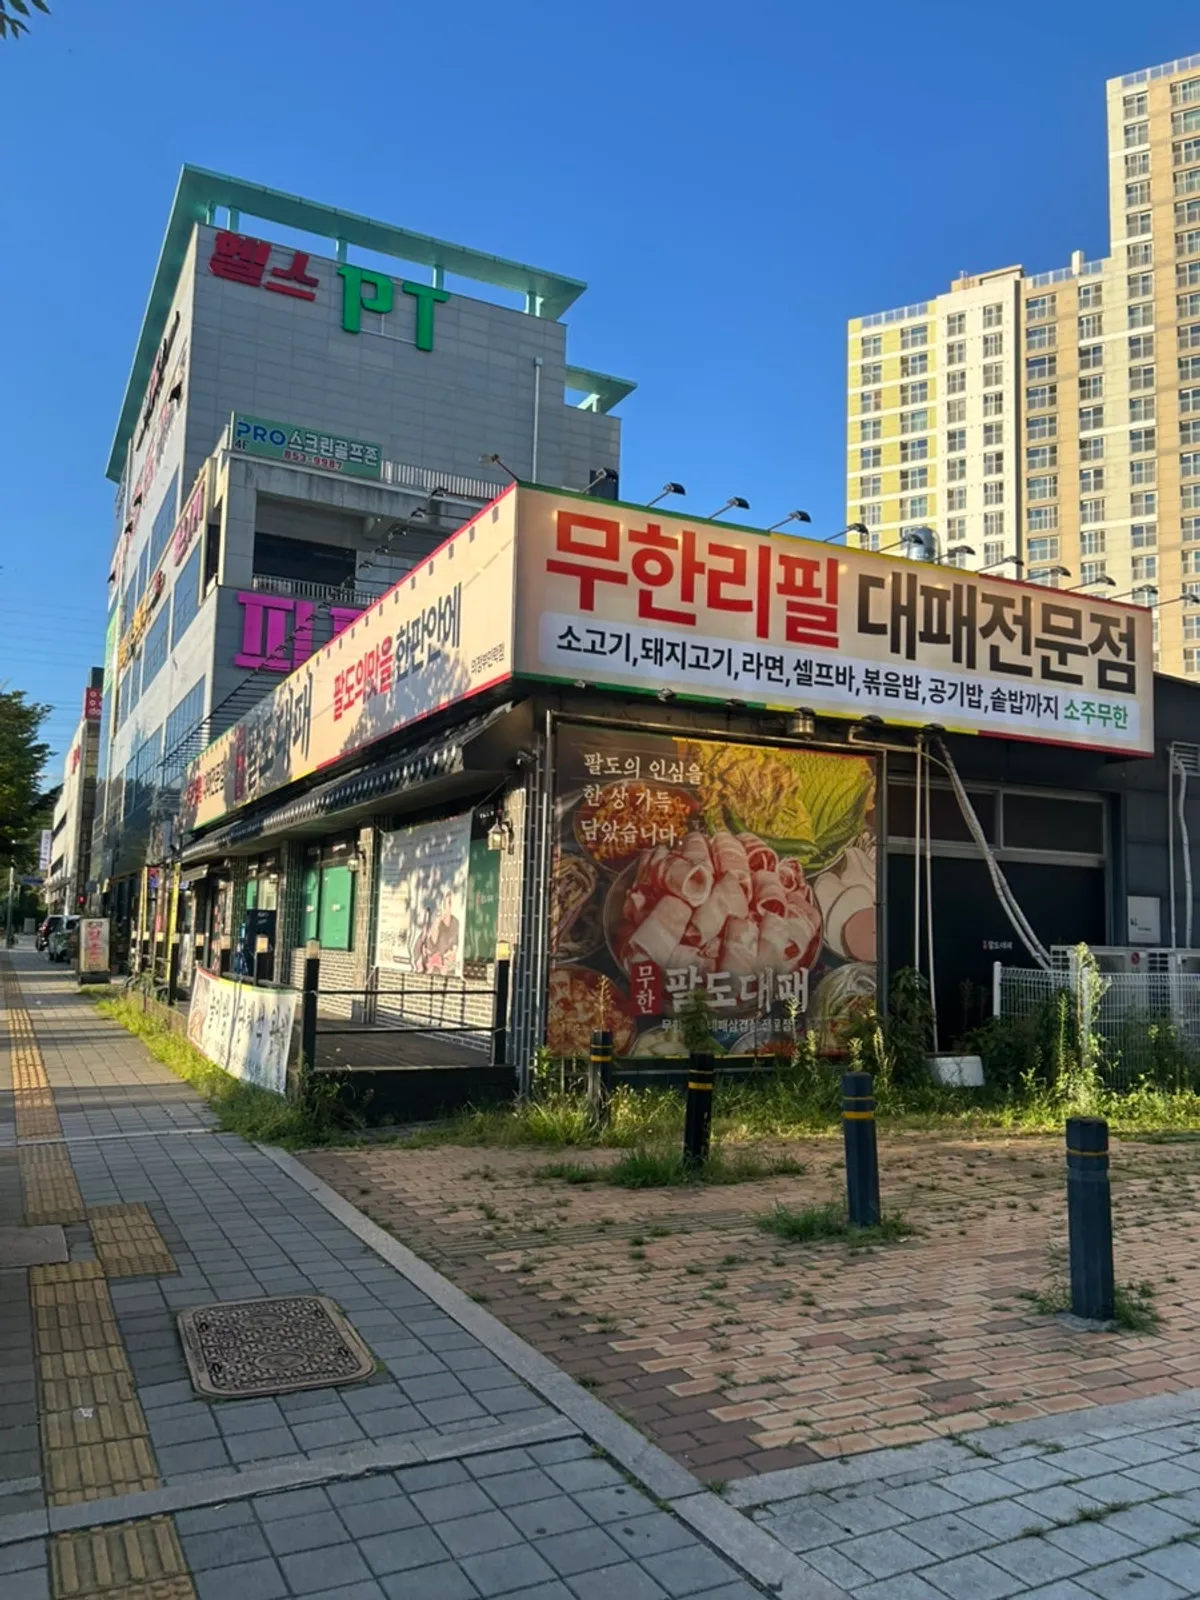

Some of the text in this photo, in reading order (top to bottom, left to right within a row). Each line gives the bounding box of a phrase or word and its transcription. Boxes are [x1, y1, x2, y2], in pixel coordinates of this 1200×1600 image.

[208, 231, 451, 353] 헬스 PT
[236, 421, 378, 467] PRO 스크린골프존
[546, 510, 1136, 694] 무한리필 대패전문점
[1063, 700, 1128, 730] 소주무한
[584, 752, 703, 785] 팔도의 인심을
[584, 784, 672, 812] 한 상 가득
[581, 817, 683, 847] 담았습니다.
[636, 965, 656, 1014] 무한
[666, 965, 810, 1013] 팔도대패
